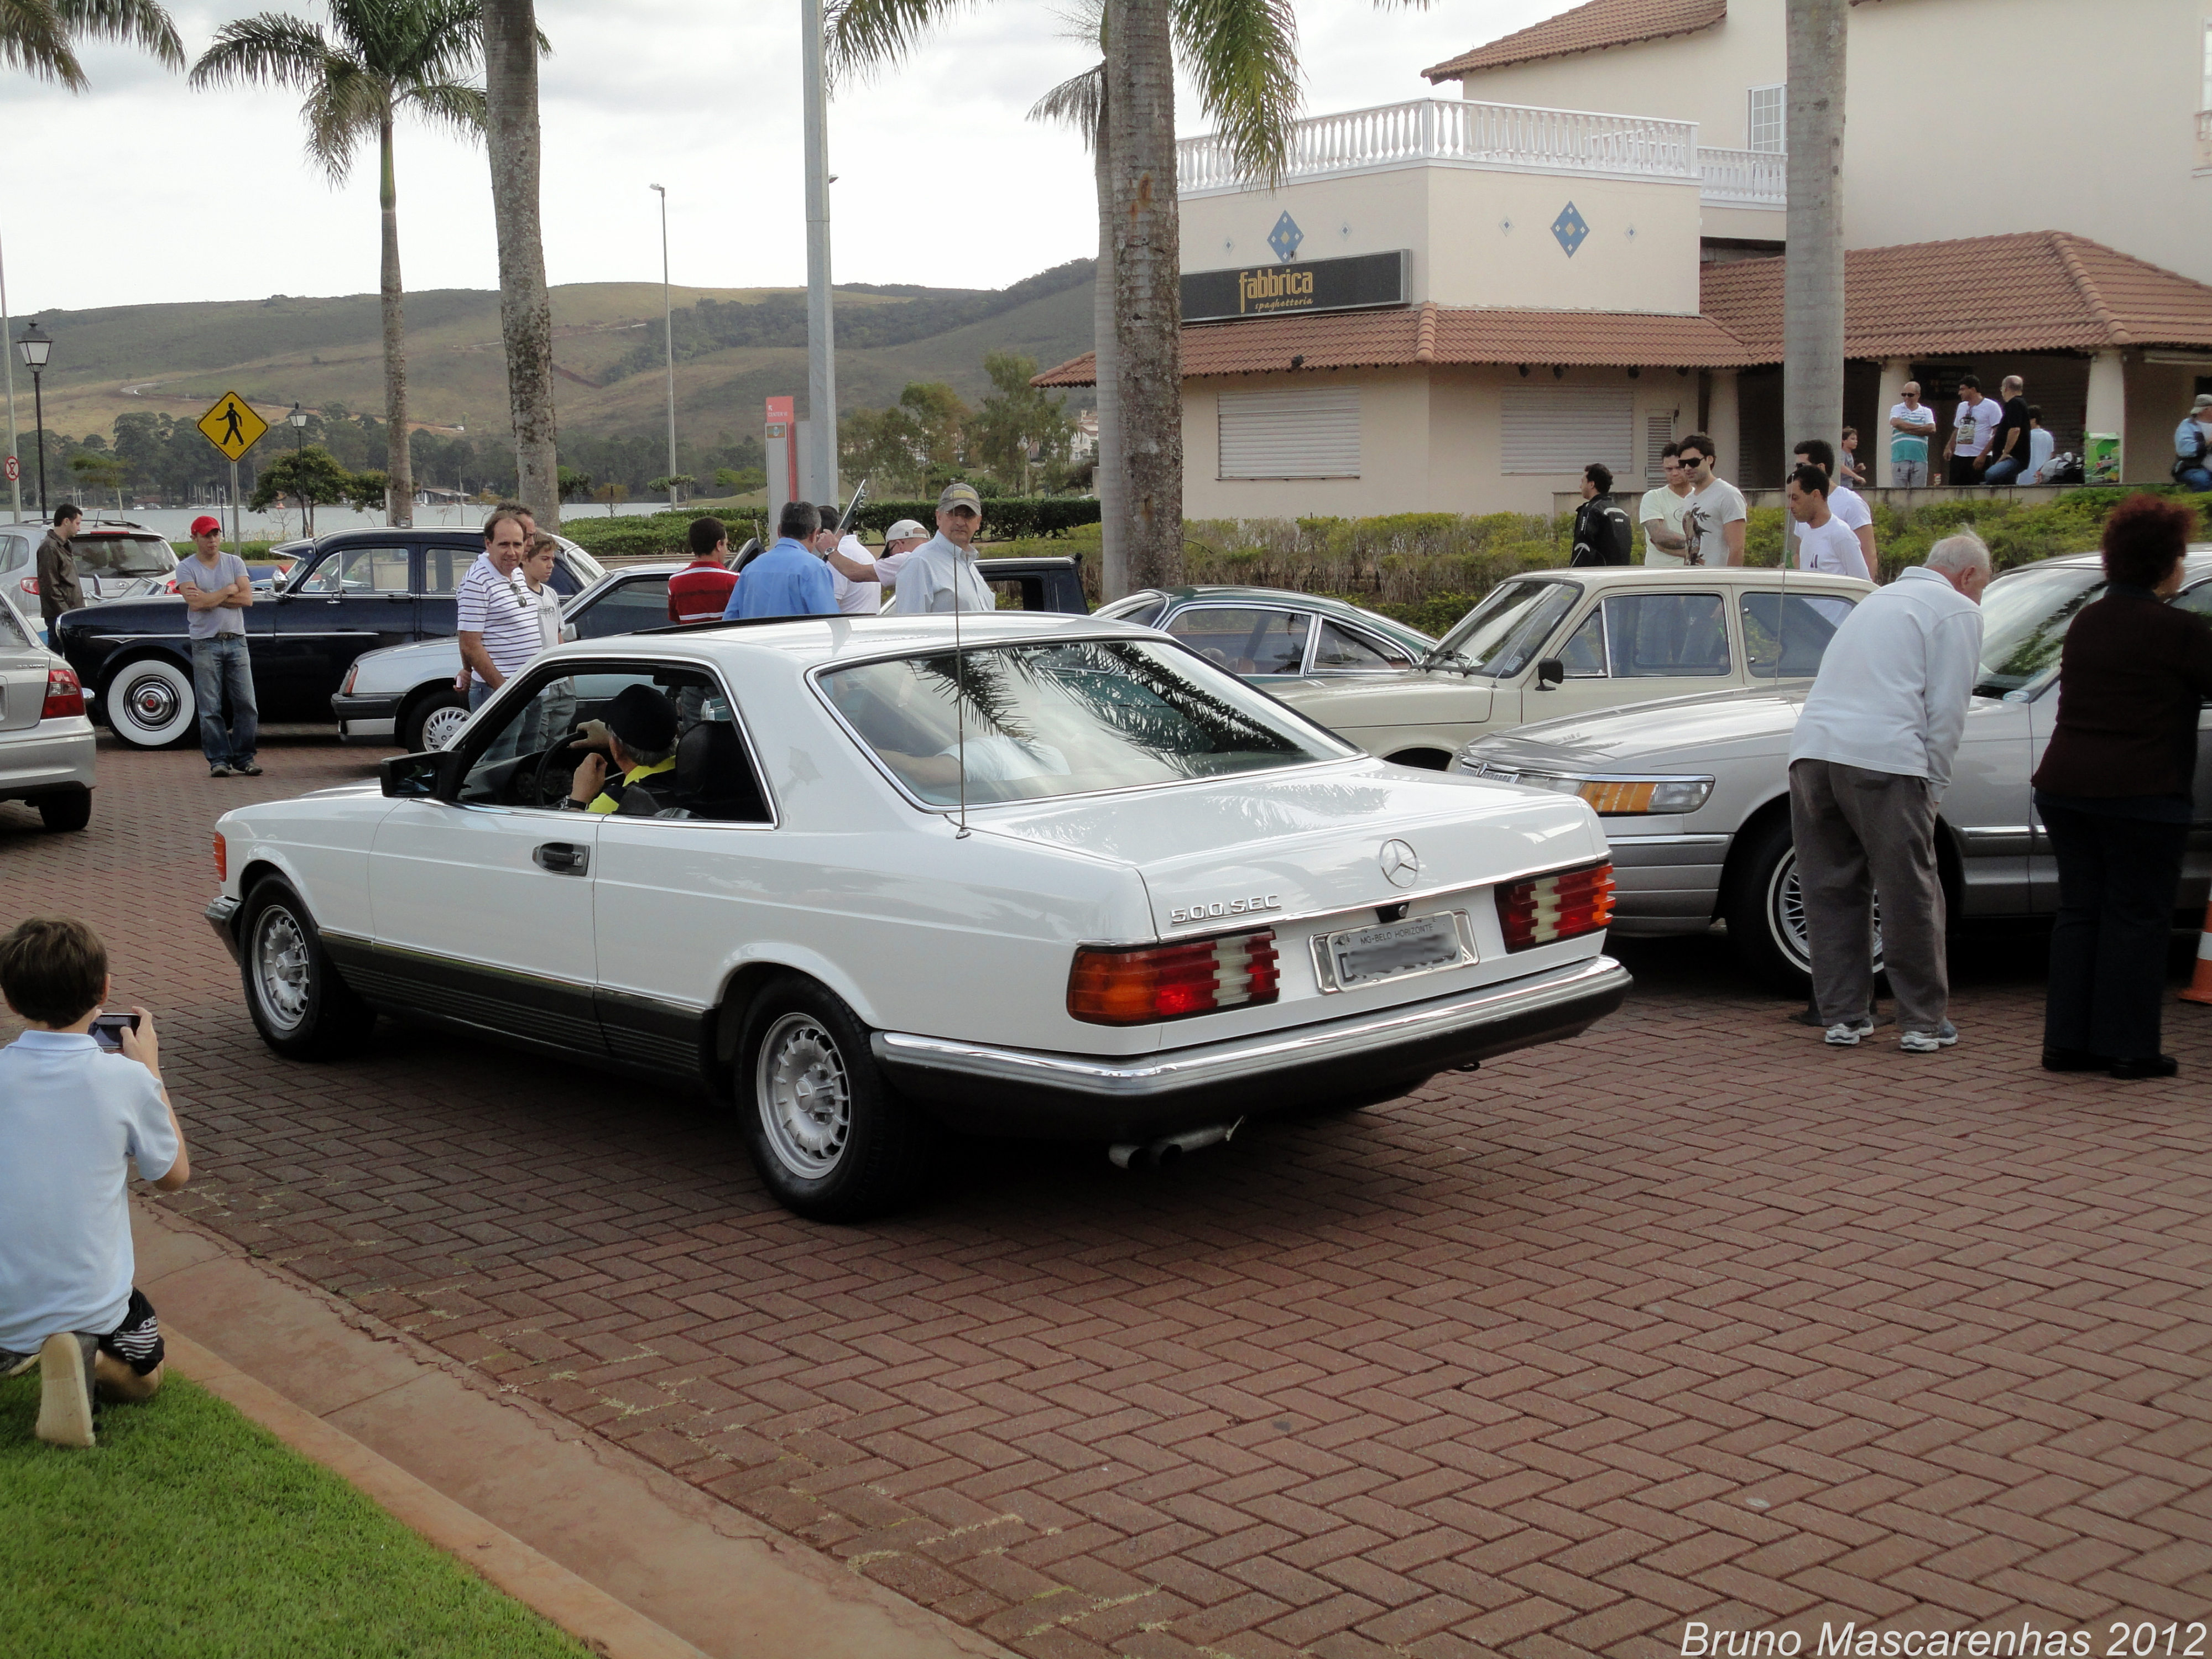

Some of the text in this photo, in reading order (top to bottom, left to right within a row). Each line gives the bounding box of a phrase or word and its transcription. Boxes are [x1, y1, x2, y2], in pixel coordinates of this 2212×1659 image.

[1239, 269, 1313, 313] fabbrica
[1255, 296, 1313, 312] spaghetteria
[1171, 894, 1282, 923] 500 SEC
[1360, 924, 1433, 945] MG-BELO HORIZONTE
